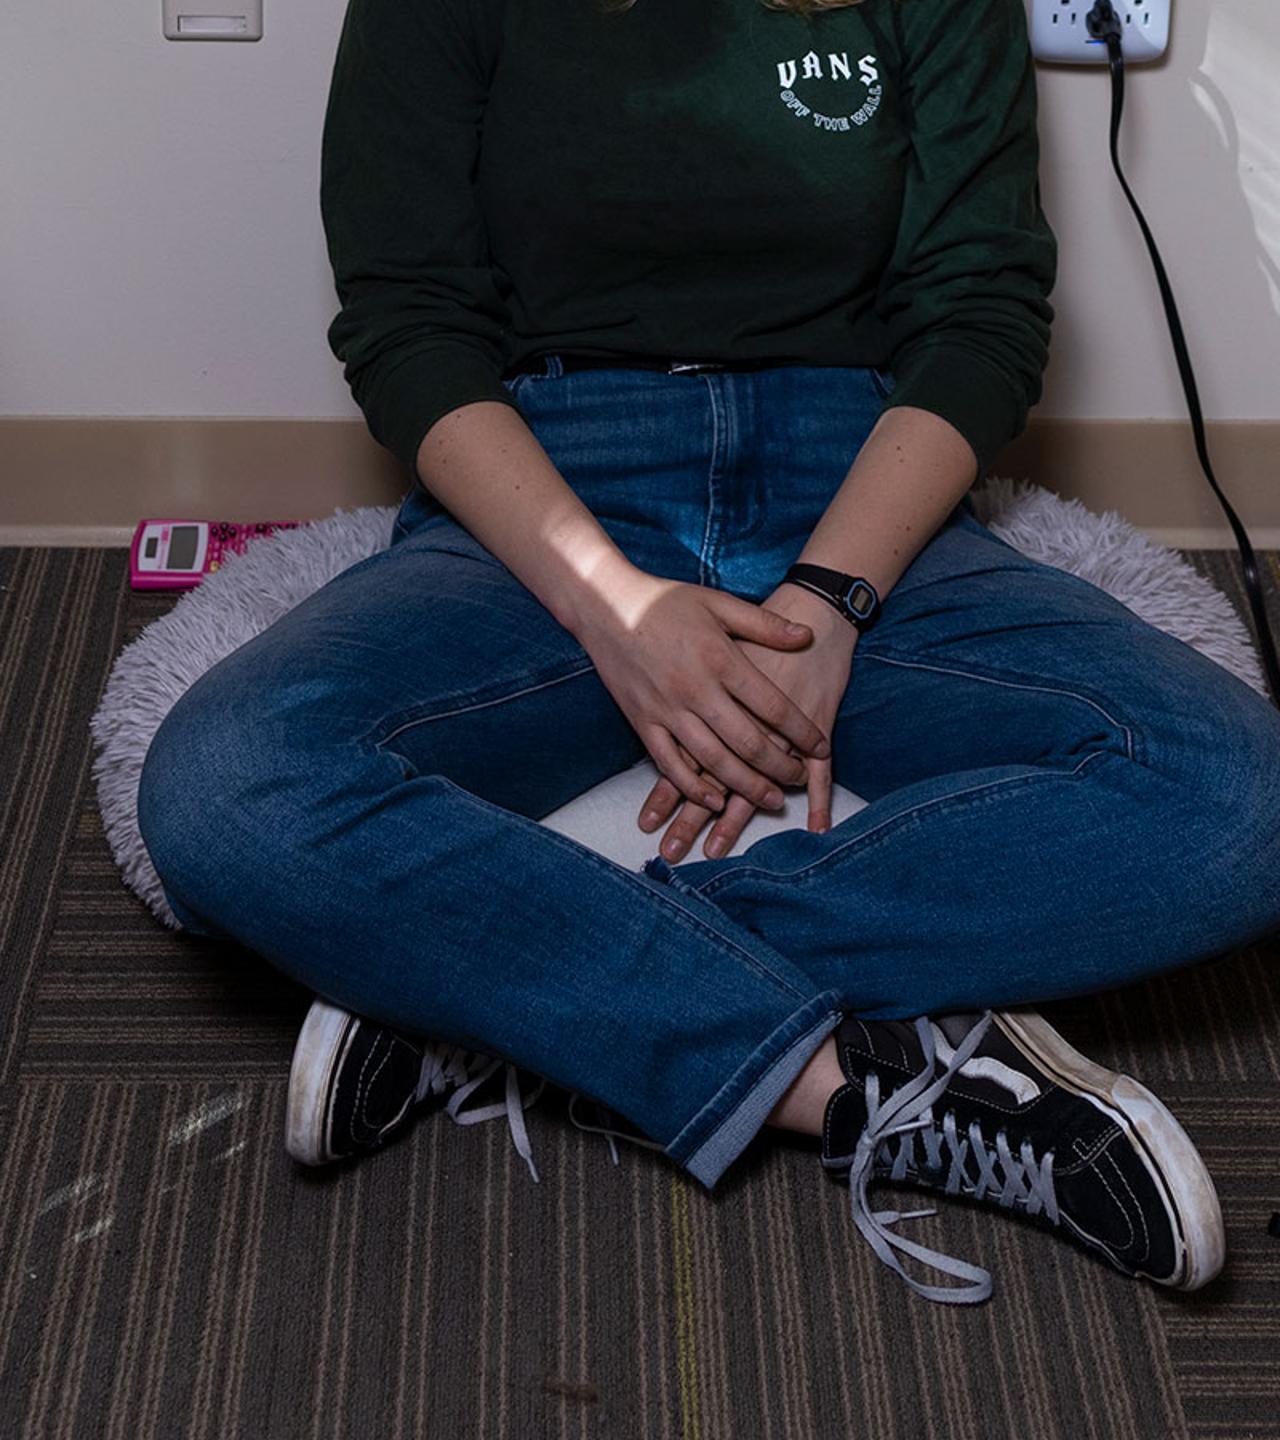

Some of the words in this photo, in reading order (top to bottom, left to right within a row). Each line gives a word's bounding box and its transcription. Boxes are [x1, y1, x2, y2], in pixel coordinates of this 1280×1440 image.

[776, 50, 879, 89] VANS
[780, 89, 811, 118] OFF
[813, 112, 851, 132] THE
[850, 84, 883, 126] WALL
